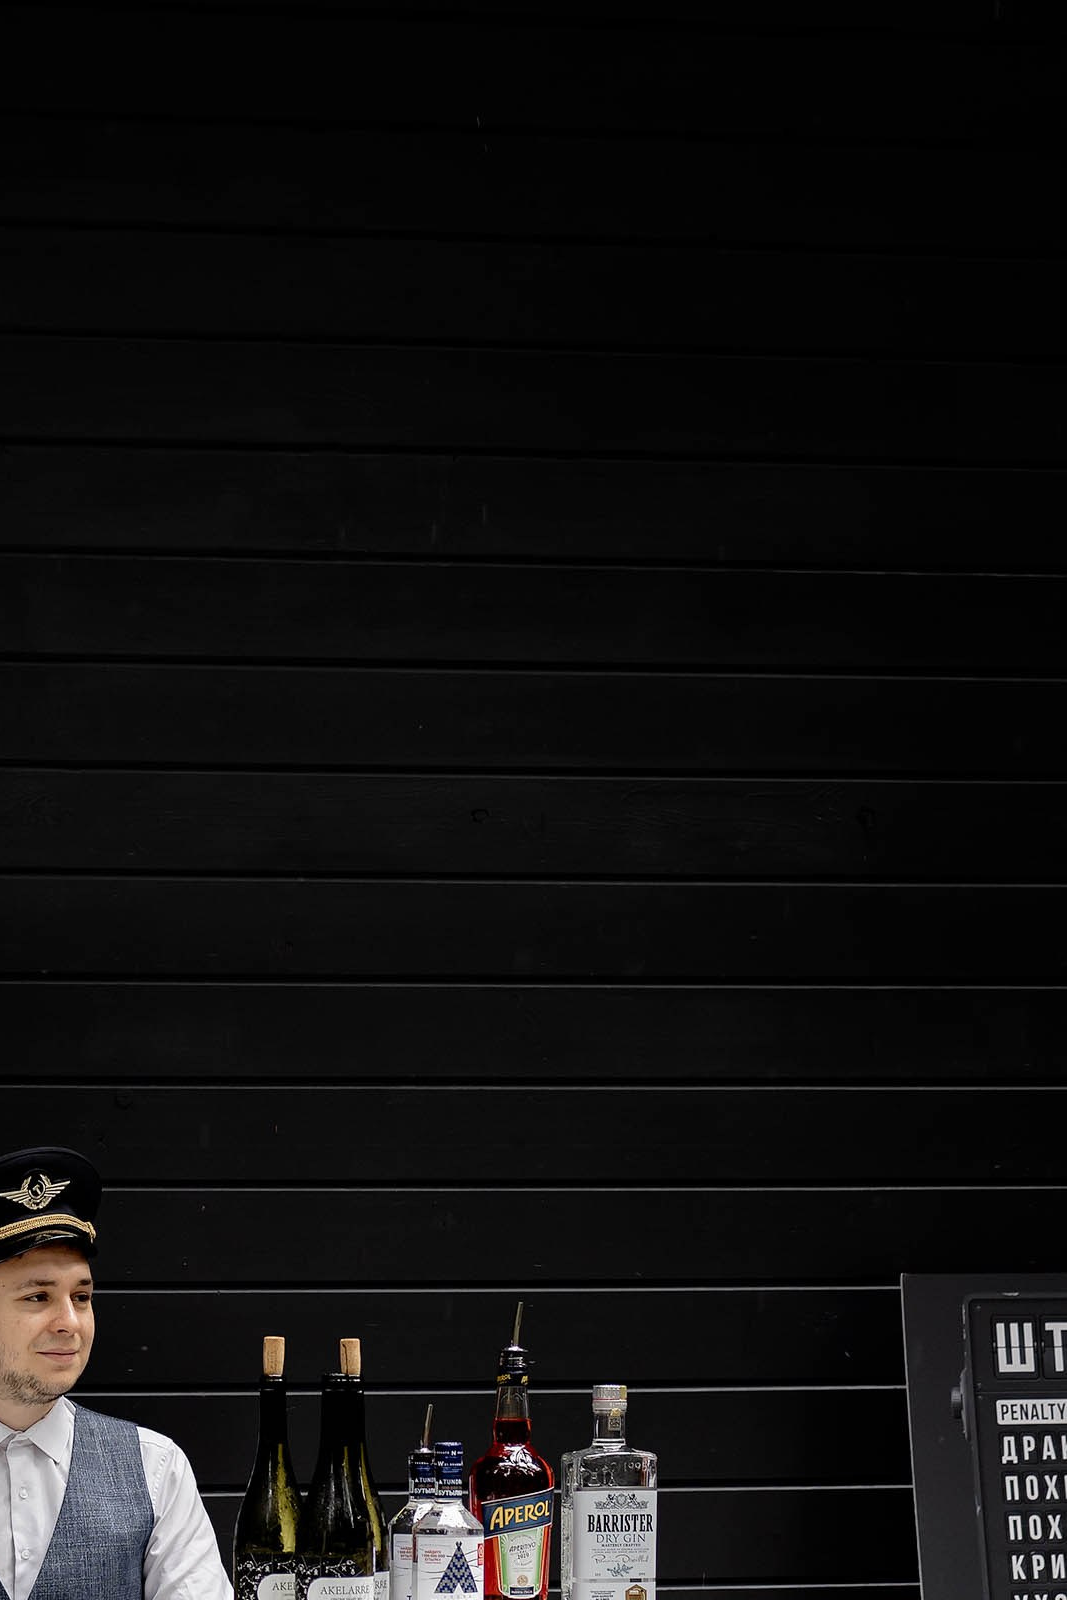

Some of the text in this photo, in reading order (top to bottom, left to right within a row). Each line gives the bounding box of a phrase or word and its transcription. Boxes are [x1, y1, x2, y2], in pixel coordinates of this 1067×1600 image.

[1000, 1402, 1066, 1421] PENALTY
[1005, 1474, 1067, 1501] ПОХ
[489, 1500, 550, 1531] APEROL
[587, 1514, 653, 1533] BARRISTER
[1008, 1514, 1063, 1540] ПОХ
[596, 1534, 646, 1544] DRY GIN
[1011, 1553, 1066, 1580] КРИ
[320, 1584, 370, 1596] AKELARRE
